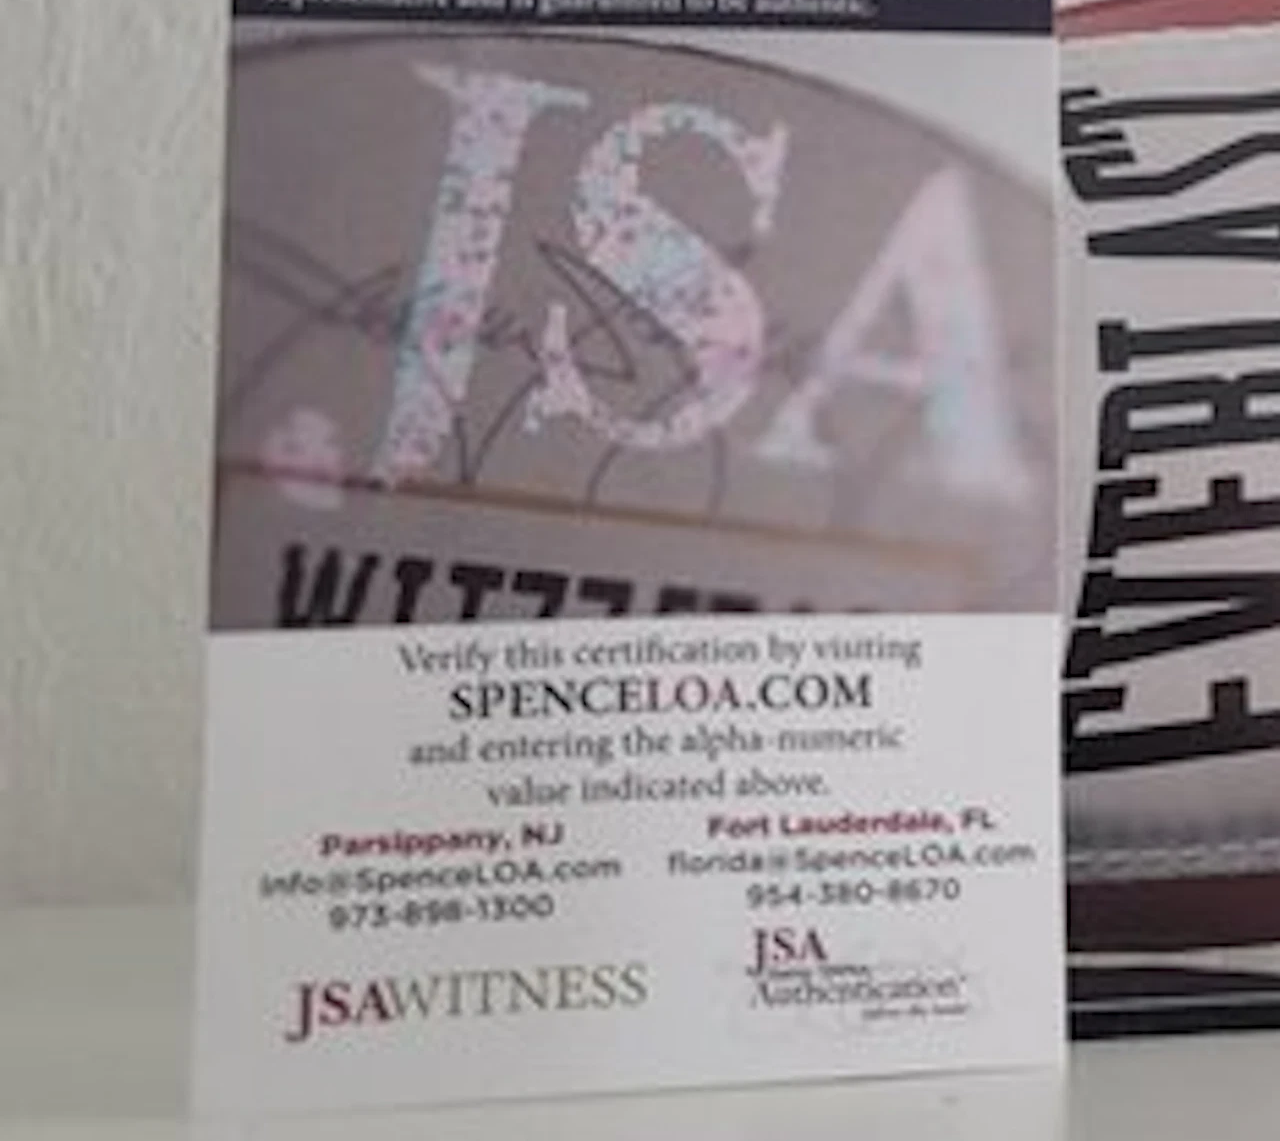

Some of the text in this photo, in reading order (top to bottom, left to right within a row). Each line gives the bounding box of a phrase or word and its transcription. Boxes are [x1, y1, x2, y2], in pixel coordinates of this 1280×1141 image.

[410, 61, 1032, 499] JSA
[397, 633, 924, 677] Verify this certification by visiting
[447, 672, 875, 720] SPENCELOA.COM
[408, 720, 903, 766] and entering the alpha-numeric
[486, 767, 831, 807] value indicated above.
[319, 821, 566, 859] Parsippany, NJ
[707, 806, 997, 839] Fort Lauderdale, FL
[745, 927, 829, 977] JSA
